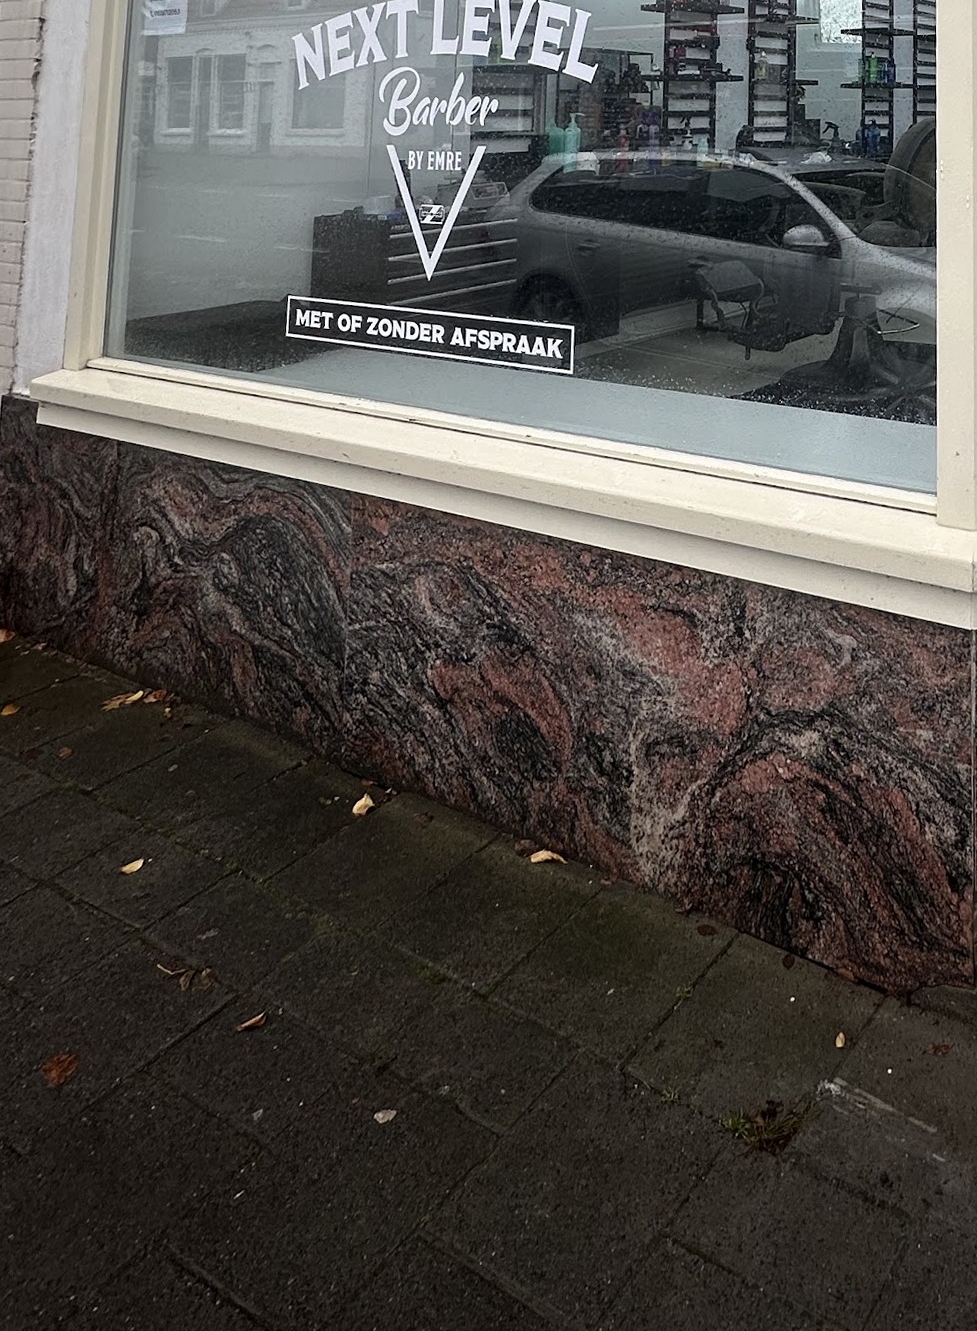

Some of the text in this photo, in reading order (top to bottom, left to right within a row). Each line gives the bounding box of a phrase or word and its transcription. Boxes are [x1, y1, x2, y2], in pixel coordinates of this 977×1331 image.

[378, 66, 499, 136] Barber
[407, 150, 463, 171] BY EMRE
[295, 309, 564, 359] MET OF ZONDER AFSPRAAK
